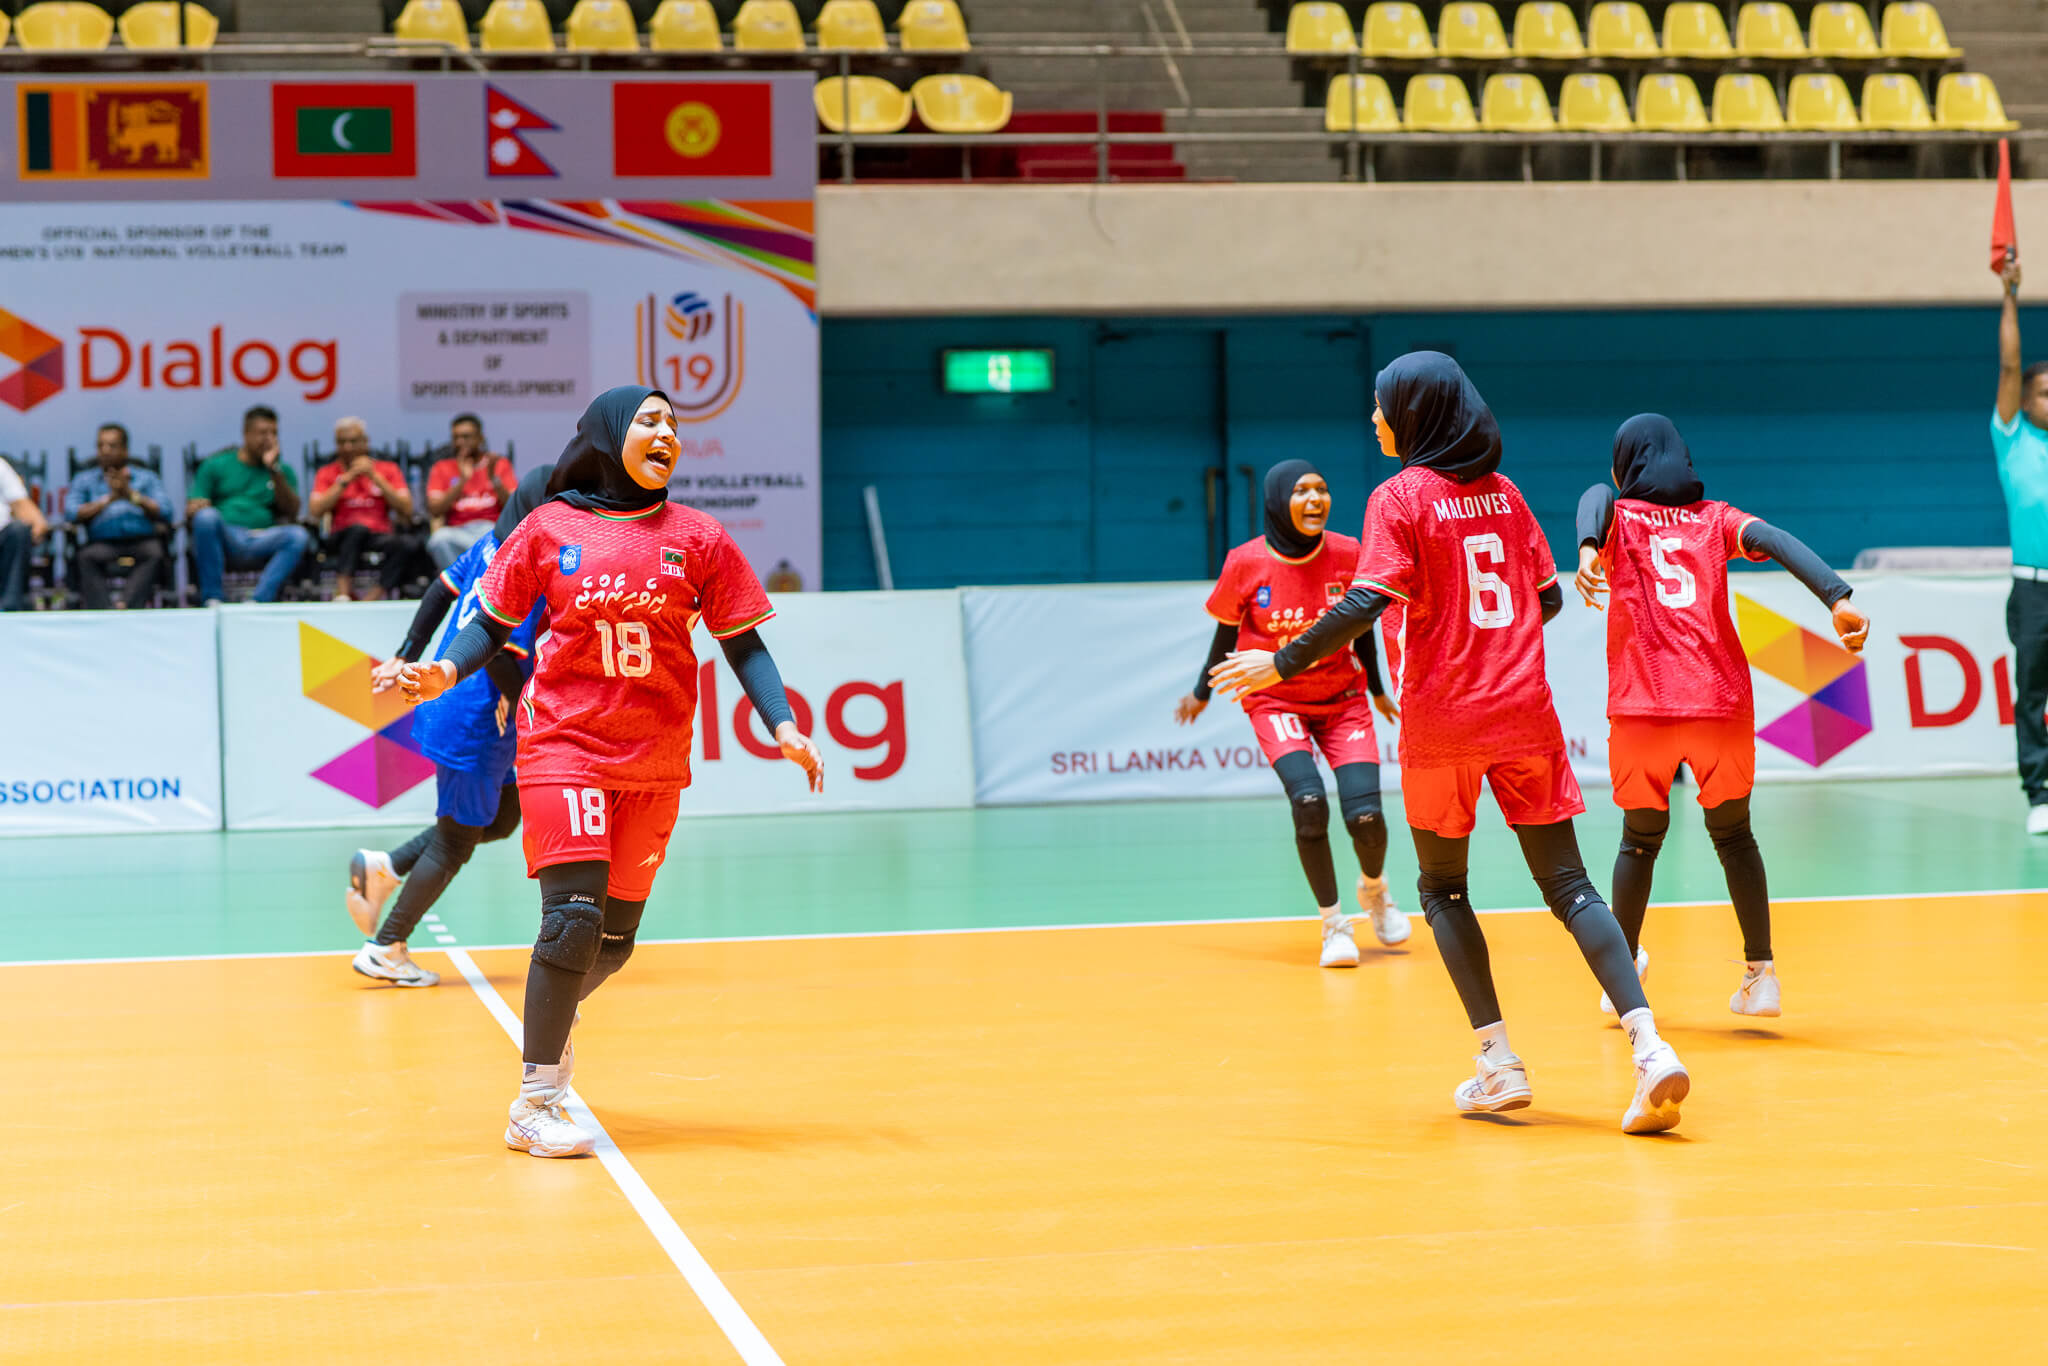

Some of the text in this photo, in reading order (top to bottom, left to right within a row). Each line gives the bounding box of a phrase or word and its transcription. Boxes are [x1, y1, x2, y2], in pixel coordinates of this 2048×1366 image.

[42, 224, 271, 240] OFFICIAL SPONSOR OF THE
[93, 245, 177, 259] NATIONAL
[186, 244, 292, 258] VOLLEYBALL
[301, 243, 347, 257] TEAM
[416, 303, 569, 320] MINISTRY OF SPORTS
[452, 328, 548, 345] DEPARTMENT
[78, 323, 339, 402] Dialog
[484, 355, 502, 371] OF
[411, 379, 577, 397] SPORTS DEVELOPMENT
[697, 474, 804, 488] VOLLEYBALL
[1432, 493, 1512, 522] MALDIVES
[1463, 533, 1515, 629] 6
[1649, 534, 1696, 609] 5
[594, 619, 652, 678] 18
[1268, 713, 1305, 742] 10
[1051, 751, 1097, 774] SRI
[1108, 748, 1206, 773] LANKA
[562, 788, 606, 836] 18
